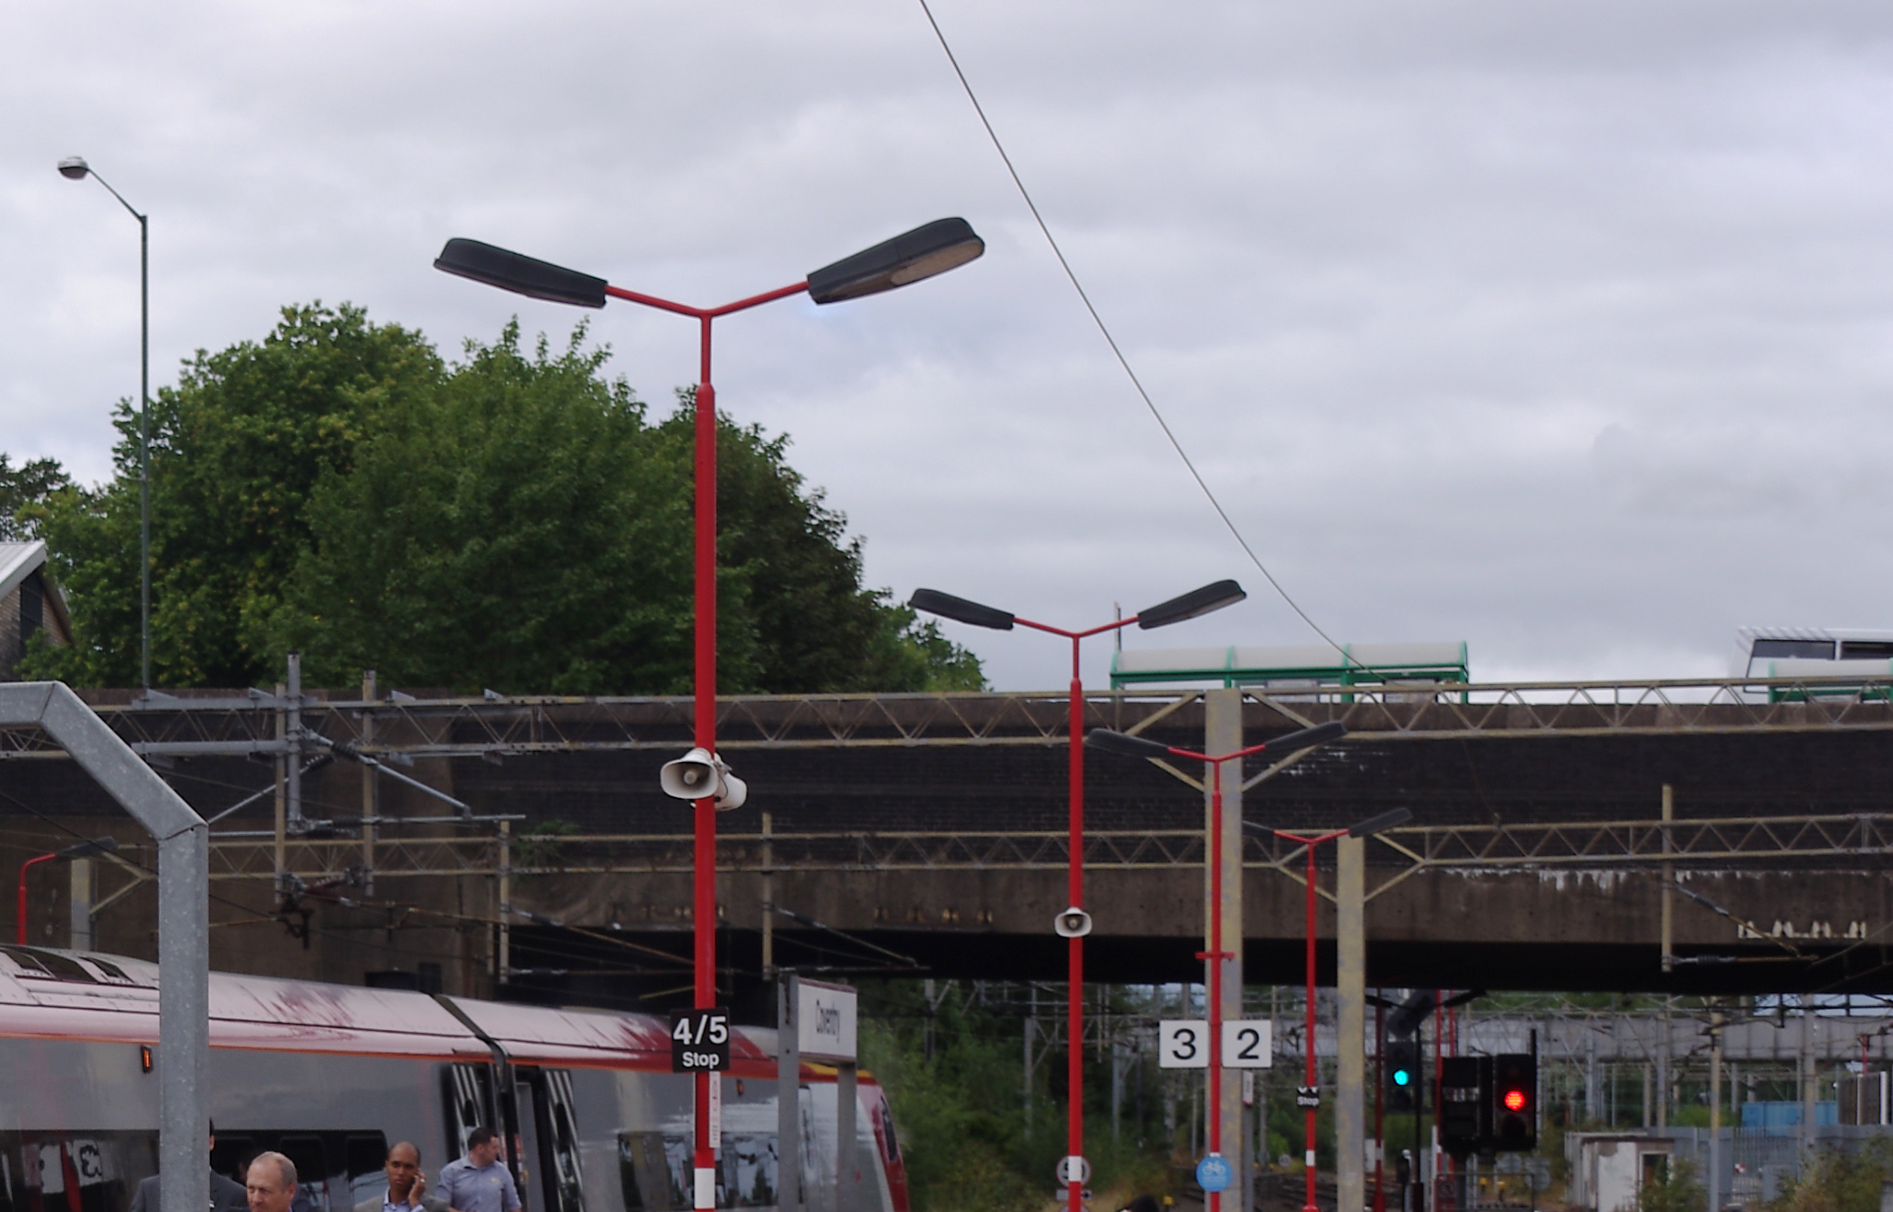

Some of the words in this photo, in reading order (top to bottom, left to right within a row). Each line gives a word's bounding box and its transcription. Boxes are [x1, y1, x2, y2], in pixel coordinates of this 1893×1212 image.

[673, 1014, 728, 1045] 4/5
[1173, 1028, 1196, 1060] 3
[1237, 1028, 1260, 1059] 2
[682, 1051, 720, 1070] Stop
